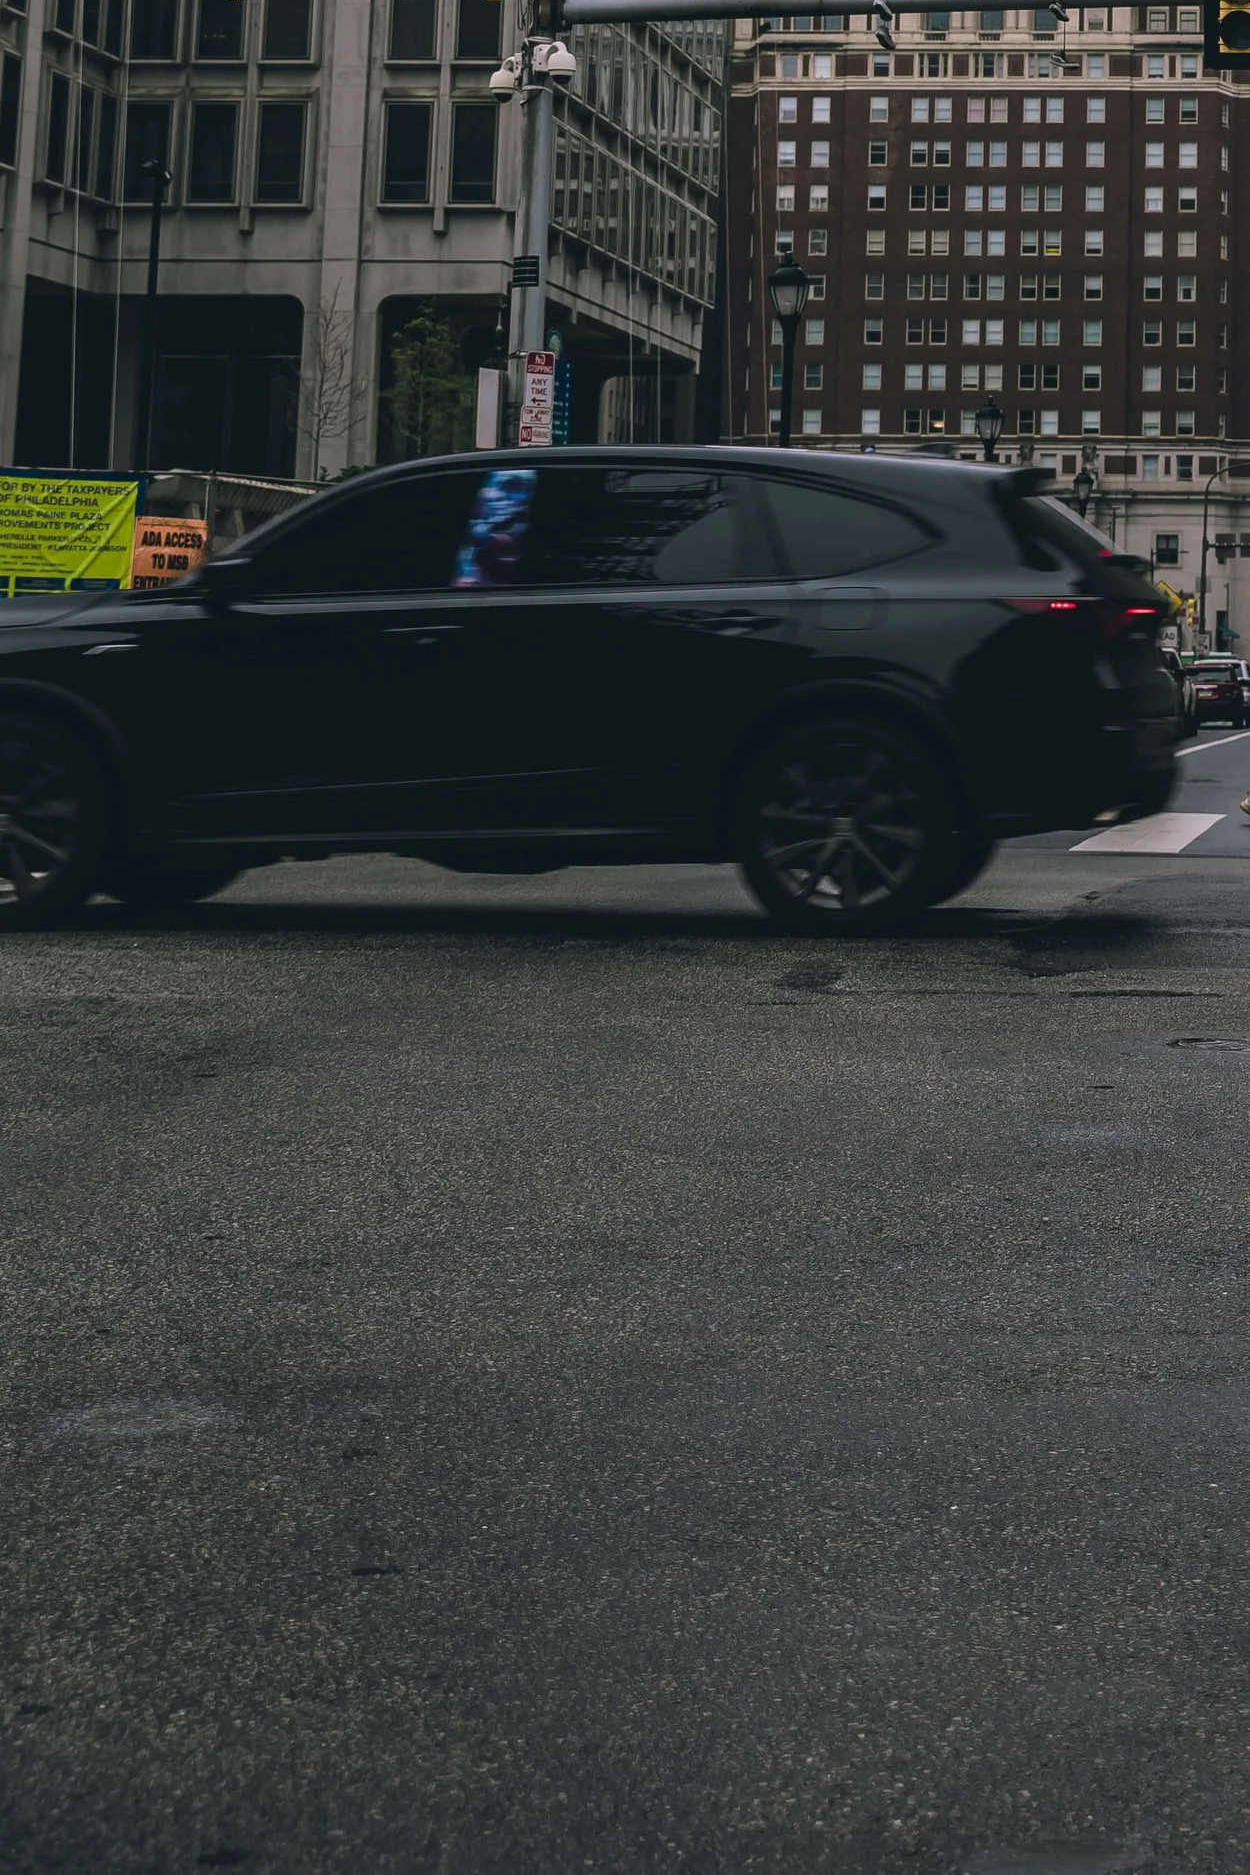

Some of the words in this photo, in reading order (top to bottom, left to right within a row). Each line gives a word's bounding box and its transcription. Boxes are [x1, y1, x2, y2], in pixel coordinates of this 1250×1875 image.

[535, 354, 546, 365] NO
[528, 365, 553, 374] STOPPING
[531, 387, 547, 395] TIME
[522, 427, 532, 441] NO
[22, 483, 36, 492] BY
[41, 484, 62, 494] THE
[66, 485, 130, 495] TAXPAYERS
[15, 495, 99, 506] PHILADELPHIA
[36, 509, 66, 519] PAINE
[70, 512, 103, 521] PLAZA
[64, 522, 110, 531] PROJECT
[141, 530, 162, 547] ADA
[164, 531, 203, 550] ACCESS
[152, 553, 166, 570] TO
[167, 554, 189, 570] MSB
